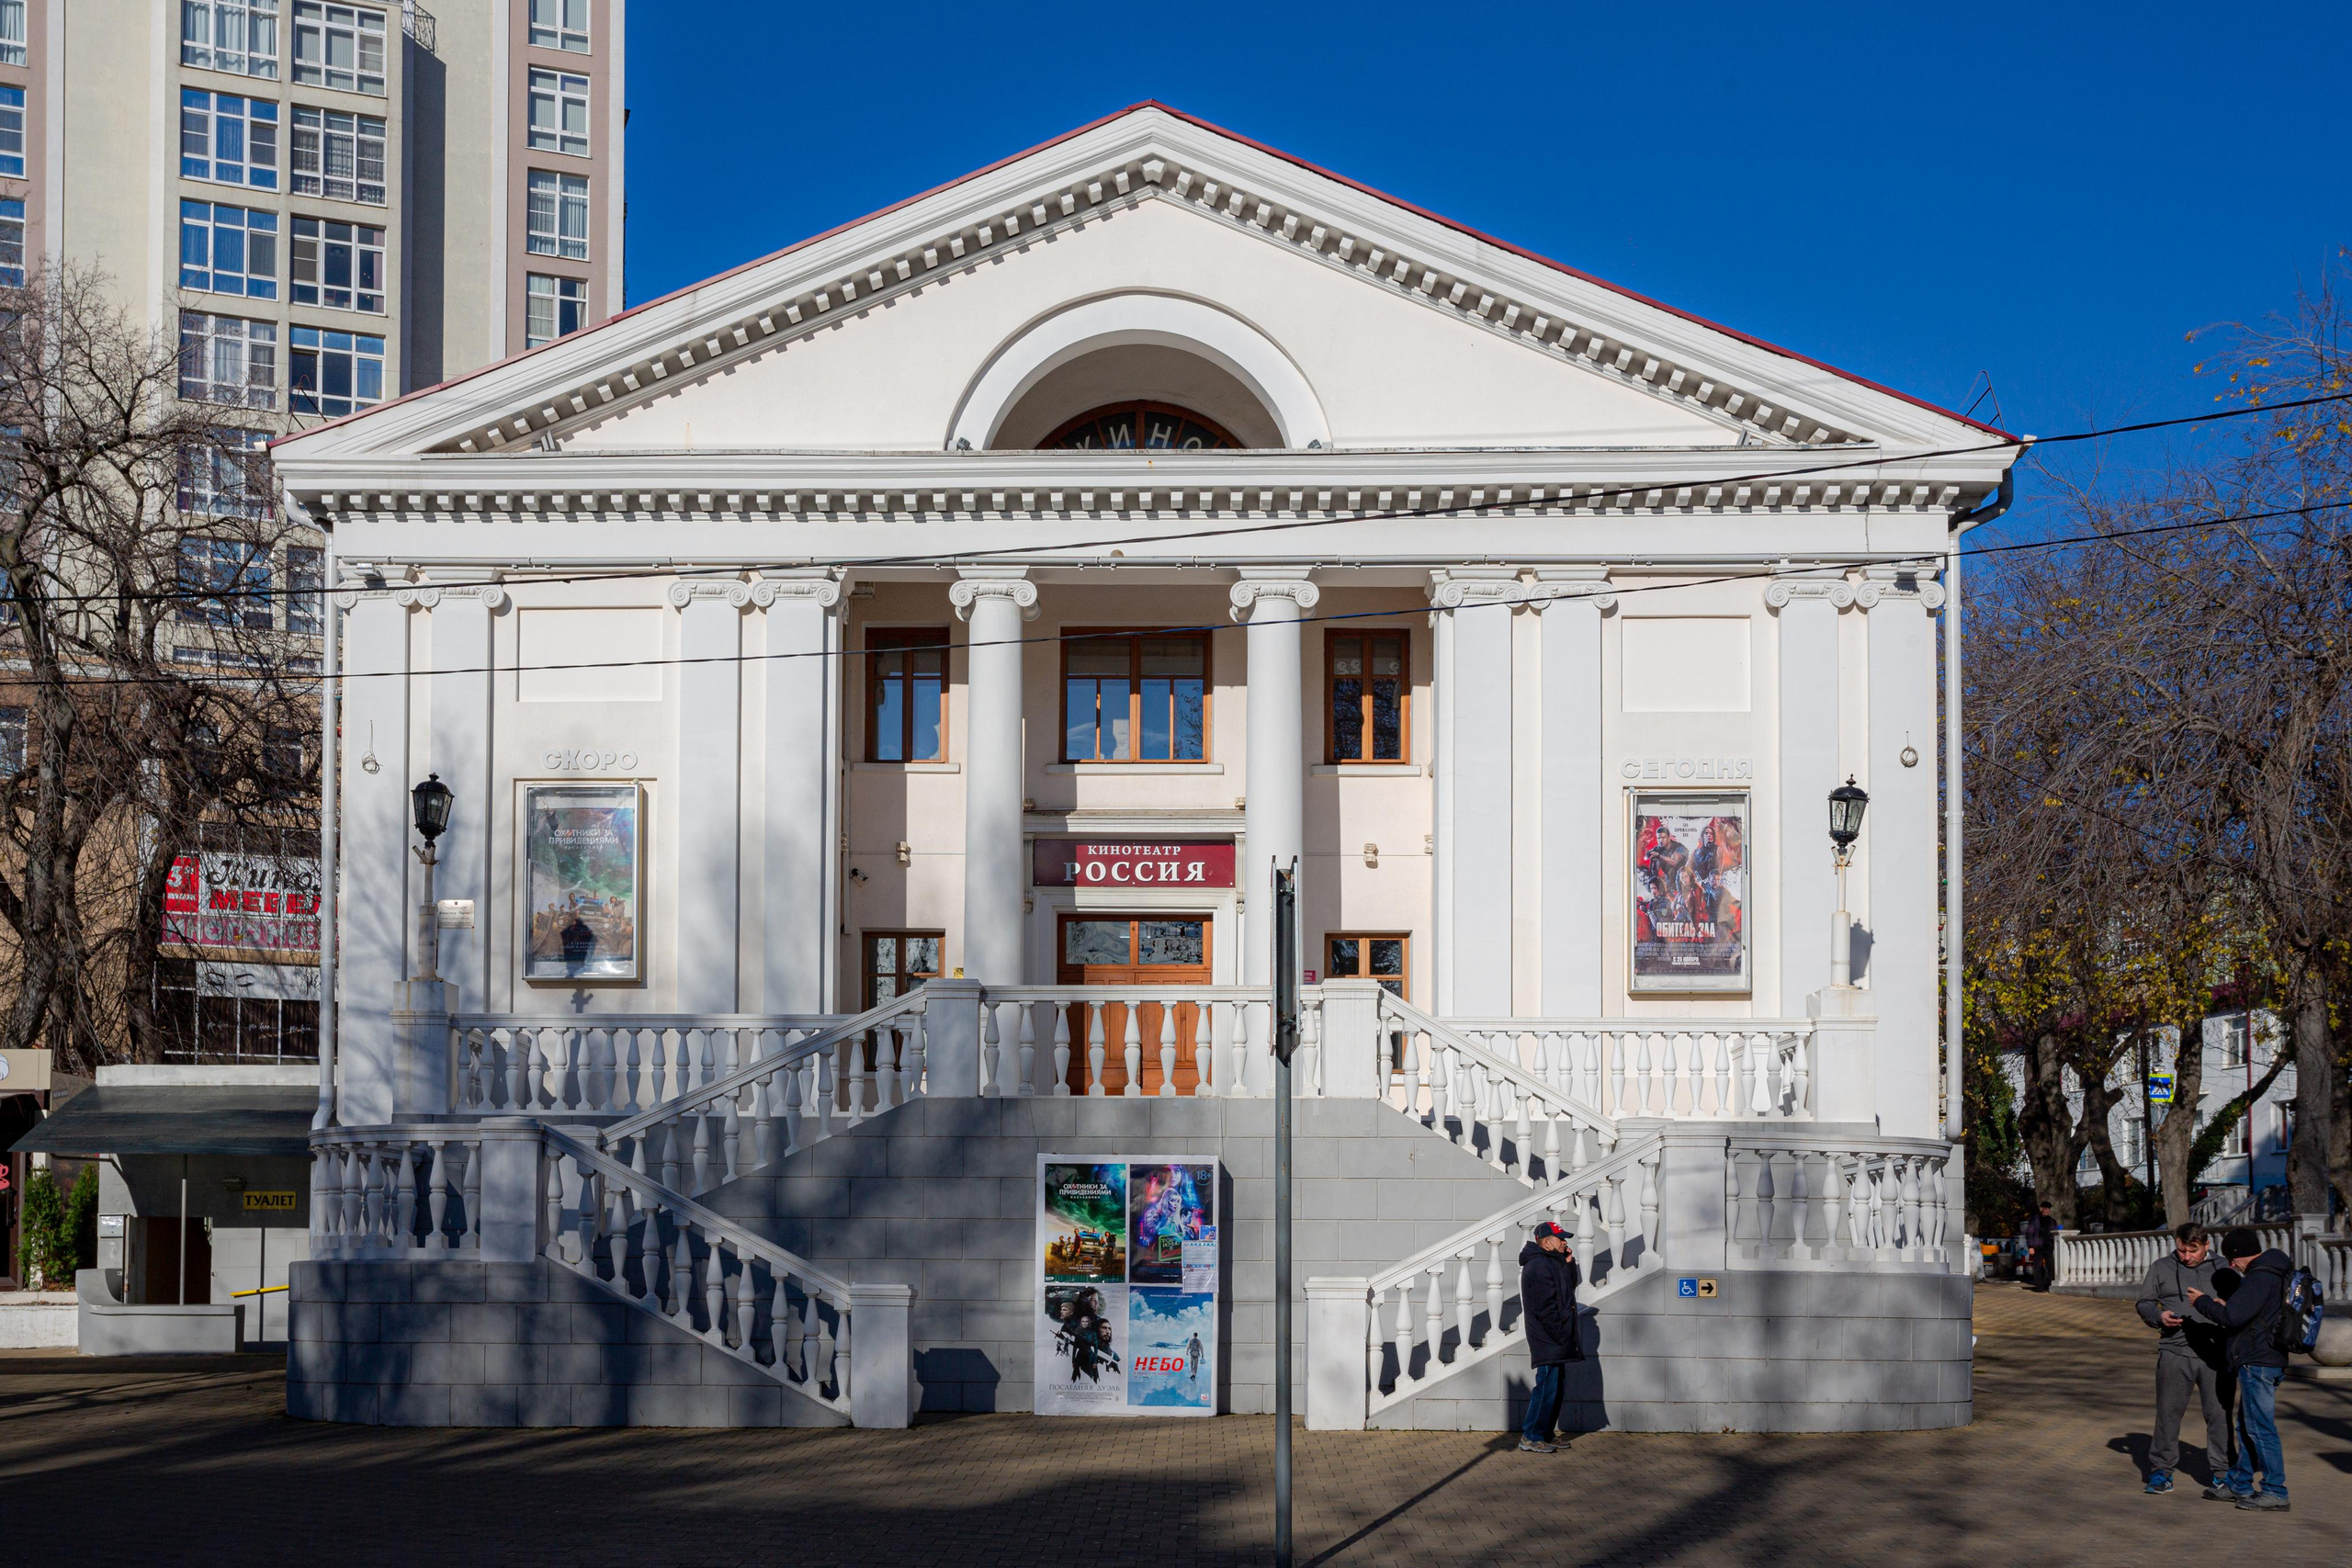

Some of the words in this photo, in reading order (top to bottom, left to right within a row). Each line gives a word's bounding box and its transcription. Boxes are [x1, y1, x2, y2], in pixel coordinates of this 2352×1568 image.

[541, 749, 639, 770] СКОРО
[1620, 757, 1753, 779] СЕГОДНЯ
[603, 829, 614, 837] ЗА
[1088, 845, 1182, 855] КИНОТЕАТР
[1063, 862, 1205, 882] РОССИЯ
[1657, 922, 1696, 938] ОБИТЕЛЬ
[1697, 922, 1715, 938] ЗЛА
[1196, 1170, 1212, 1180] 18+
[245, 1195, 294, 1205] ТУАЛЕТ
[1134, 1357, 1184, 1371] НЕБО
